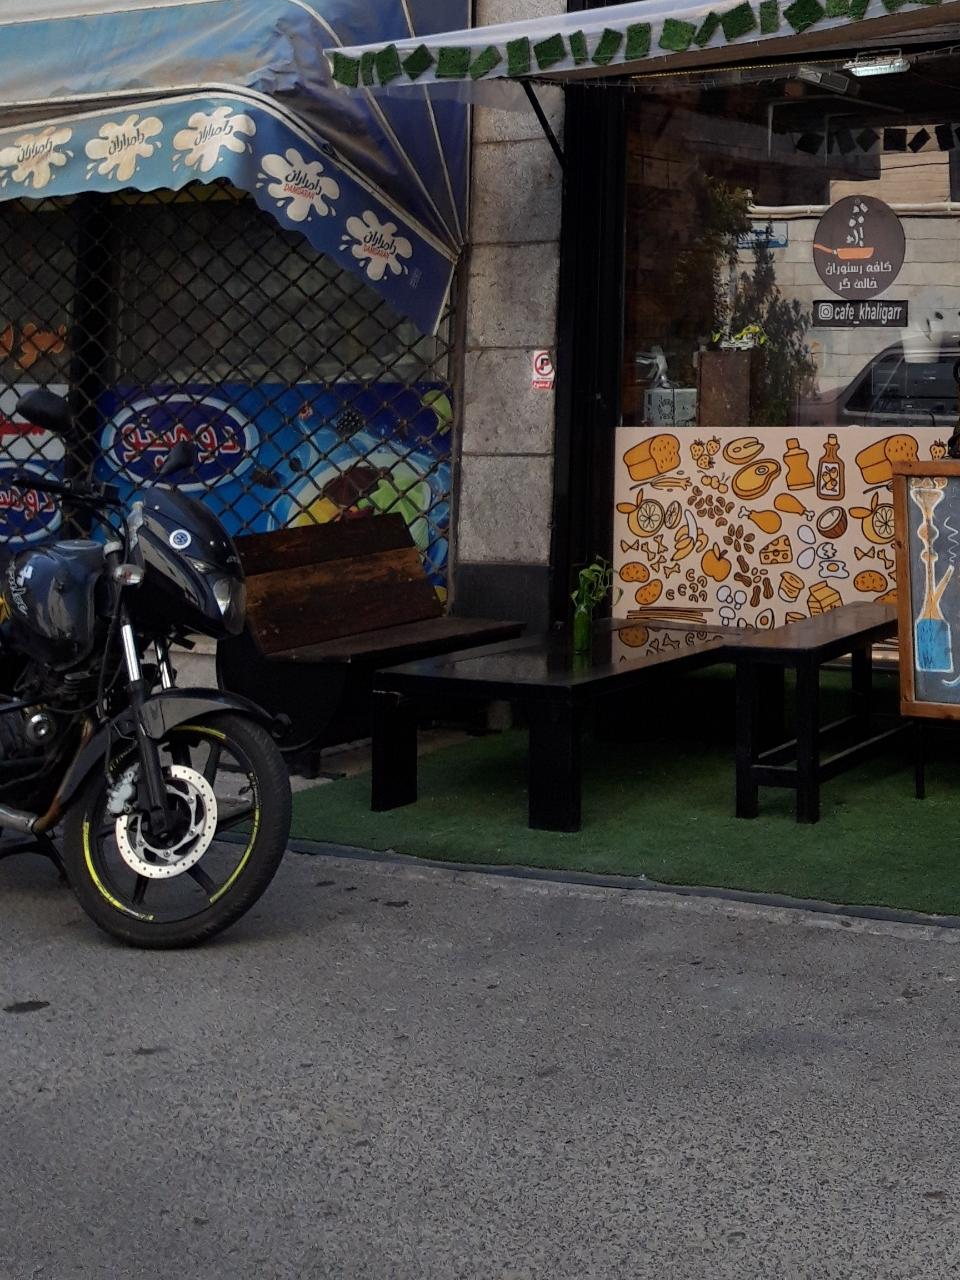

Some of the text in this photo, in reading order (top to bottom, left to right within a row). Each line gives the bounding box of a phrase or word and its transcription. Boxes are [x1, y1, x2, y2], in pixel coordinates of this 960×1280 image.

[866, 261, 892, 273] کافه
[853, 277, 879, 289] خالی
[834, 302, 903, 325] cafe_khaligarr
